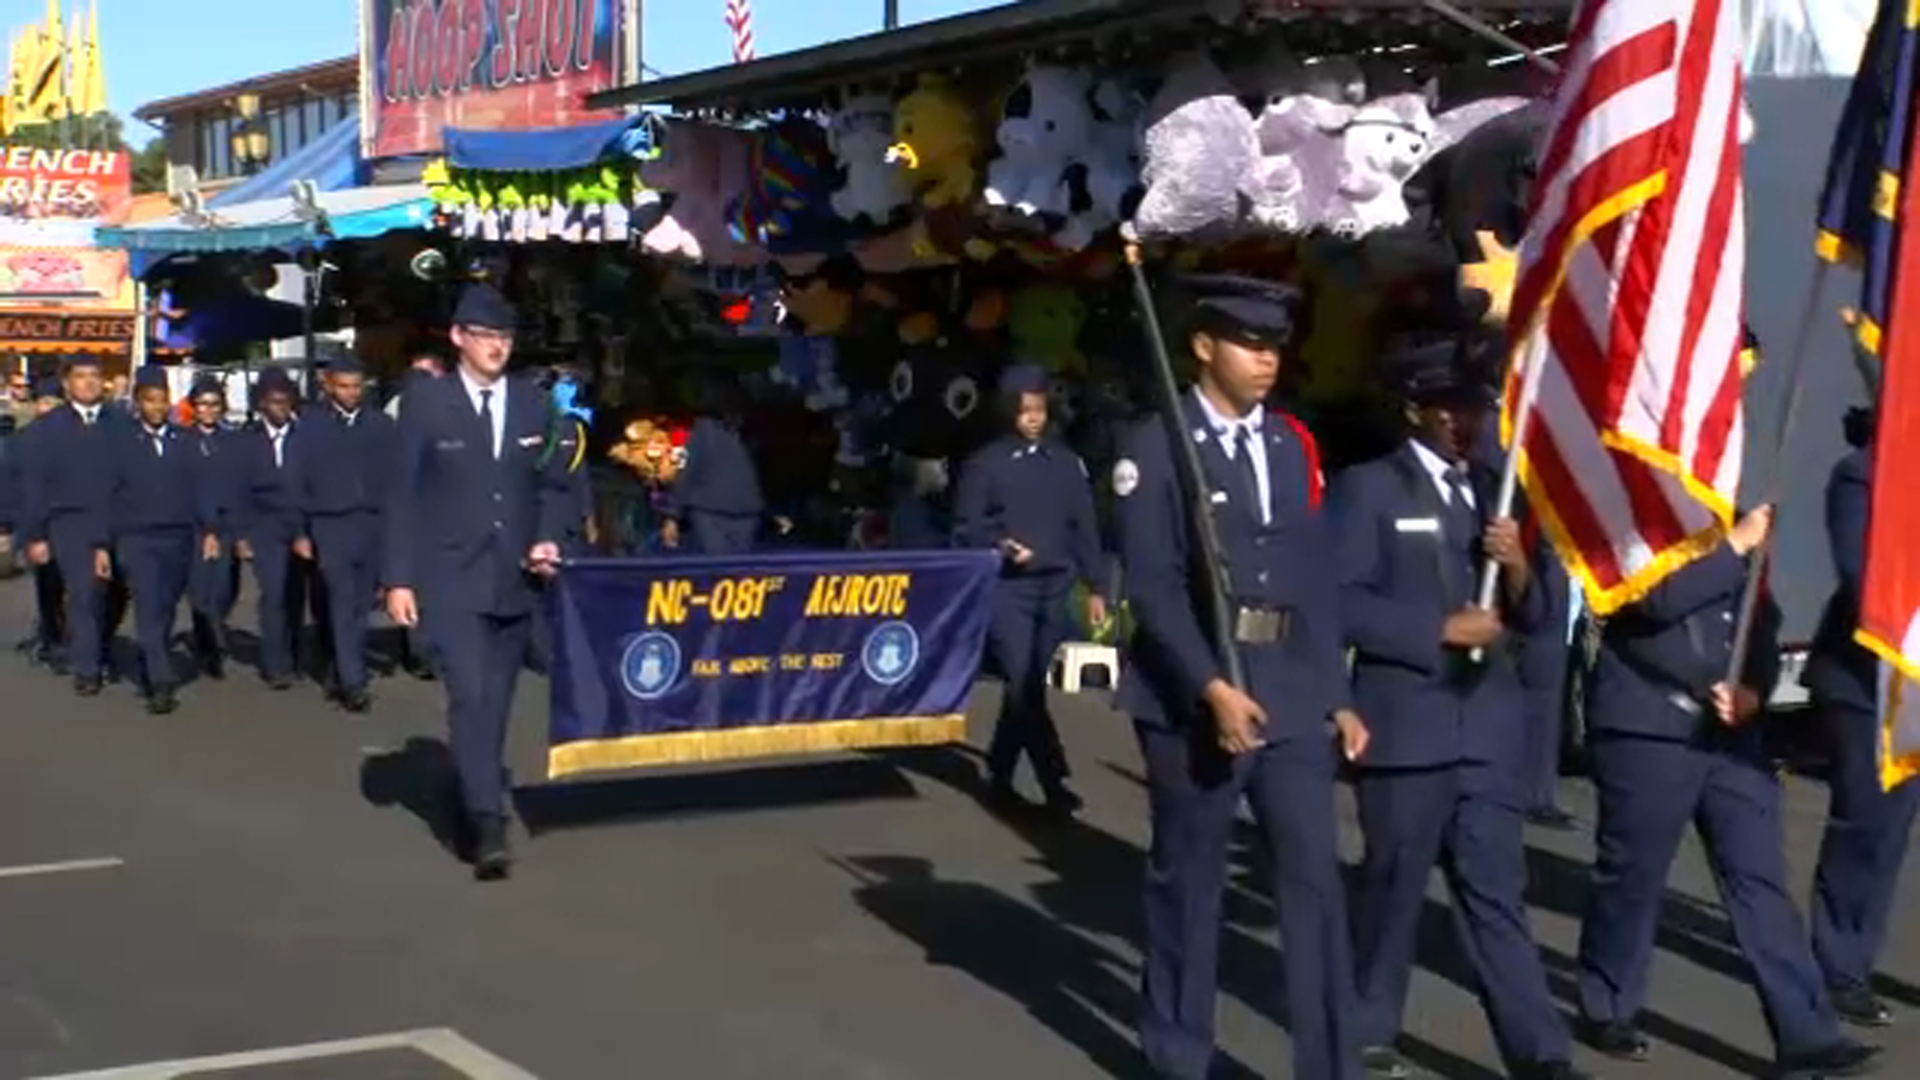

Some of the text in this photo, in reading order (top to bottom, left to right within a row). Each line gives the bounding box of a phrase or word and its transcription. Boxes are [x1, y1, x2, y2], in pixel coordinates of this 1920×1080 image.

[386, 0, 486, 102] HOOP
[0, 146, 117, 174] ENCH
[803, 574, 911, 617] AFJROTC
[780, 653, 805, 670] THE
